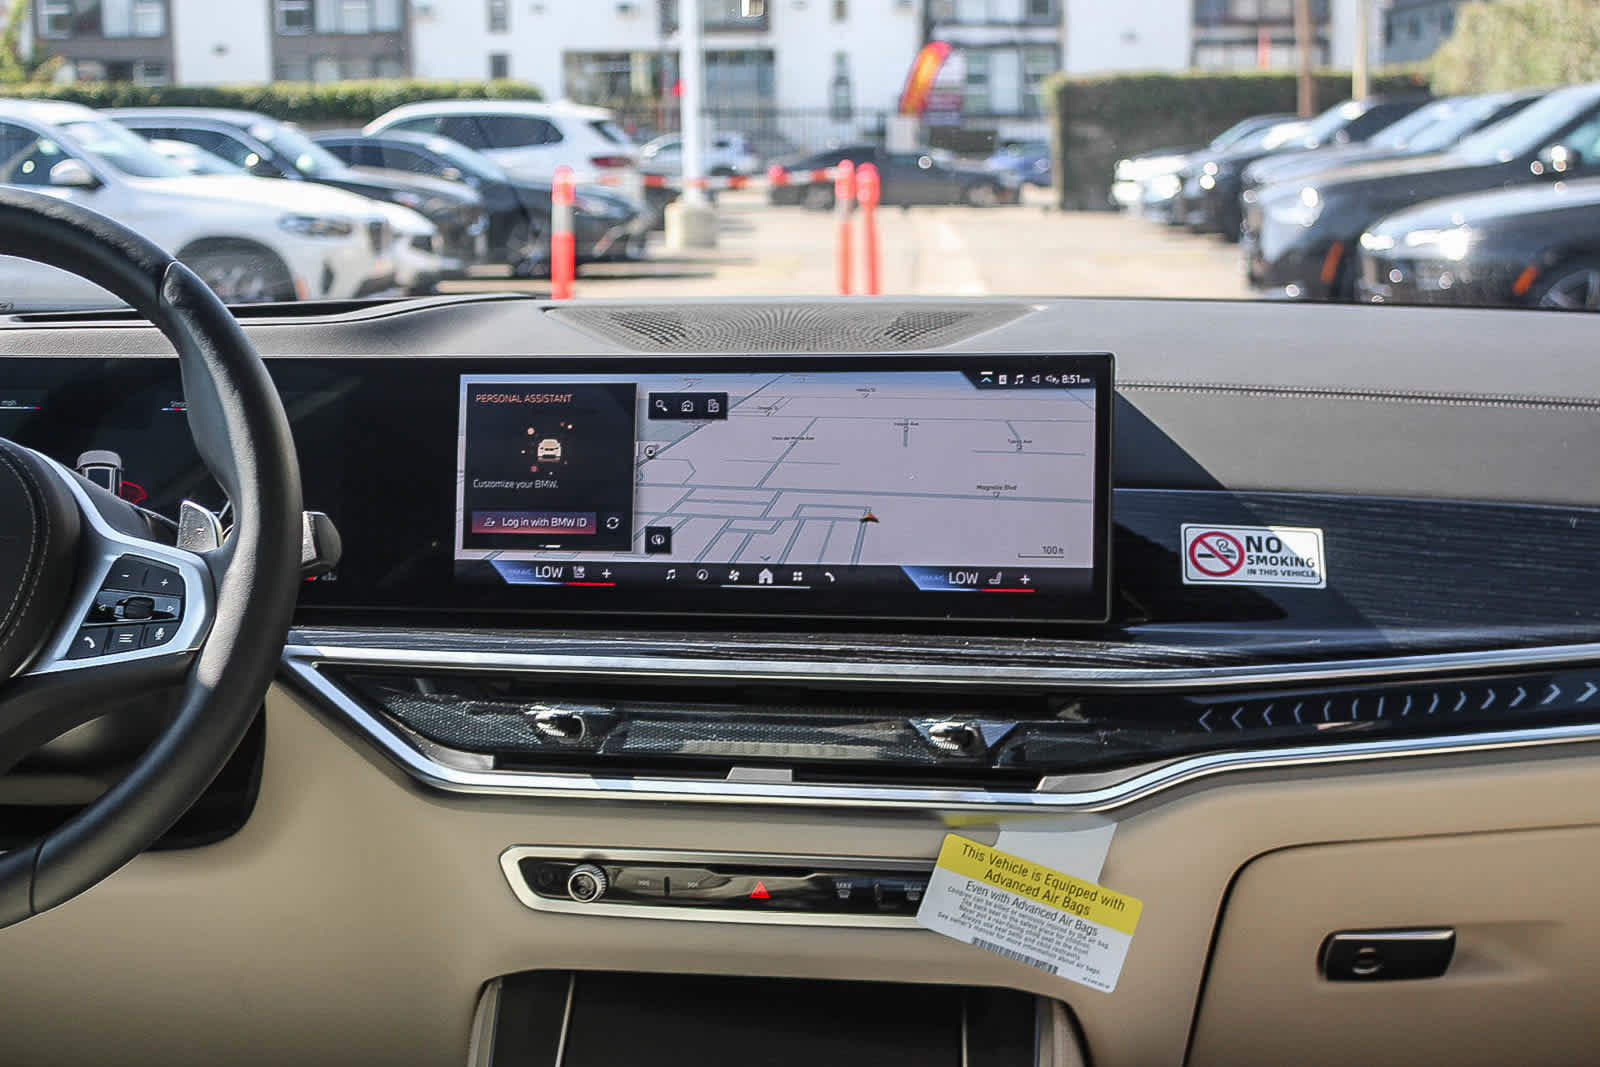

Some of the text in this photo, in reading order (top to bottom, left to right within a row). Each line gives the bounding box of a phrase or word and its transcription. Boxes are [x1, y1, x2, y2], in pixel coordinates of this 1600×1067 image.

[475, 393, 573, 403] PERSONAL ASSISTANT
[473, 479, 559, 491] Customize your BMW.
[502, 517, 588, 529] Log in with BMW ID
[1042, 546, 1058, 555] 100
[1245, 535, 1282, 554] NO
[1247, 554, 1316, 568] SMOKING
[535, 565, 563, 578] LOW
[949, 571, 979, 585] LOW
[1247, 568, 1317, 578] IN THIS VEHICLE
[960, 843, 1126, 911] This Vehicle is Equipped with
[983, 868, 1091, 917] Advanced Air Bags
[965, 880, 1098, 937] Even with Advanced Air Bags
